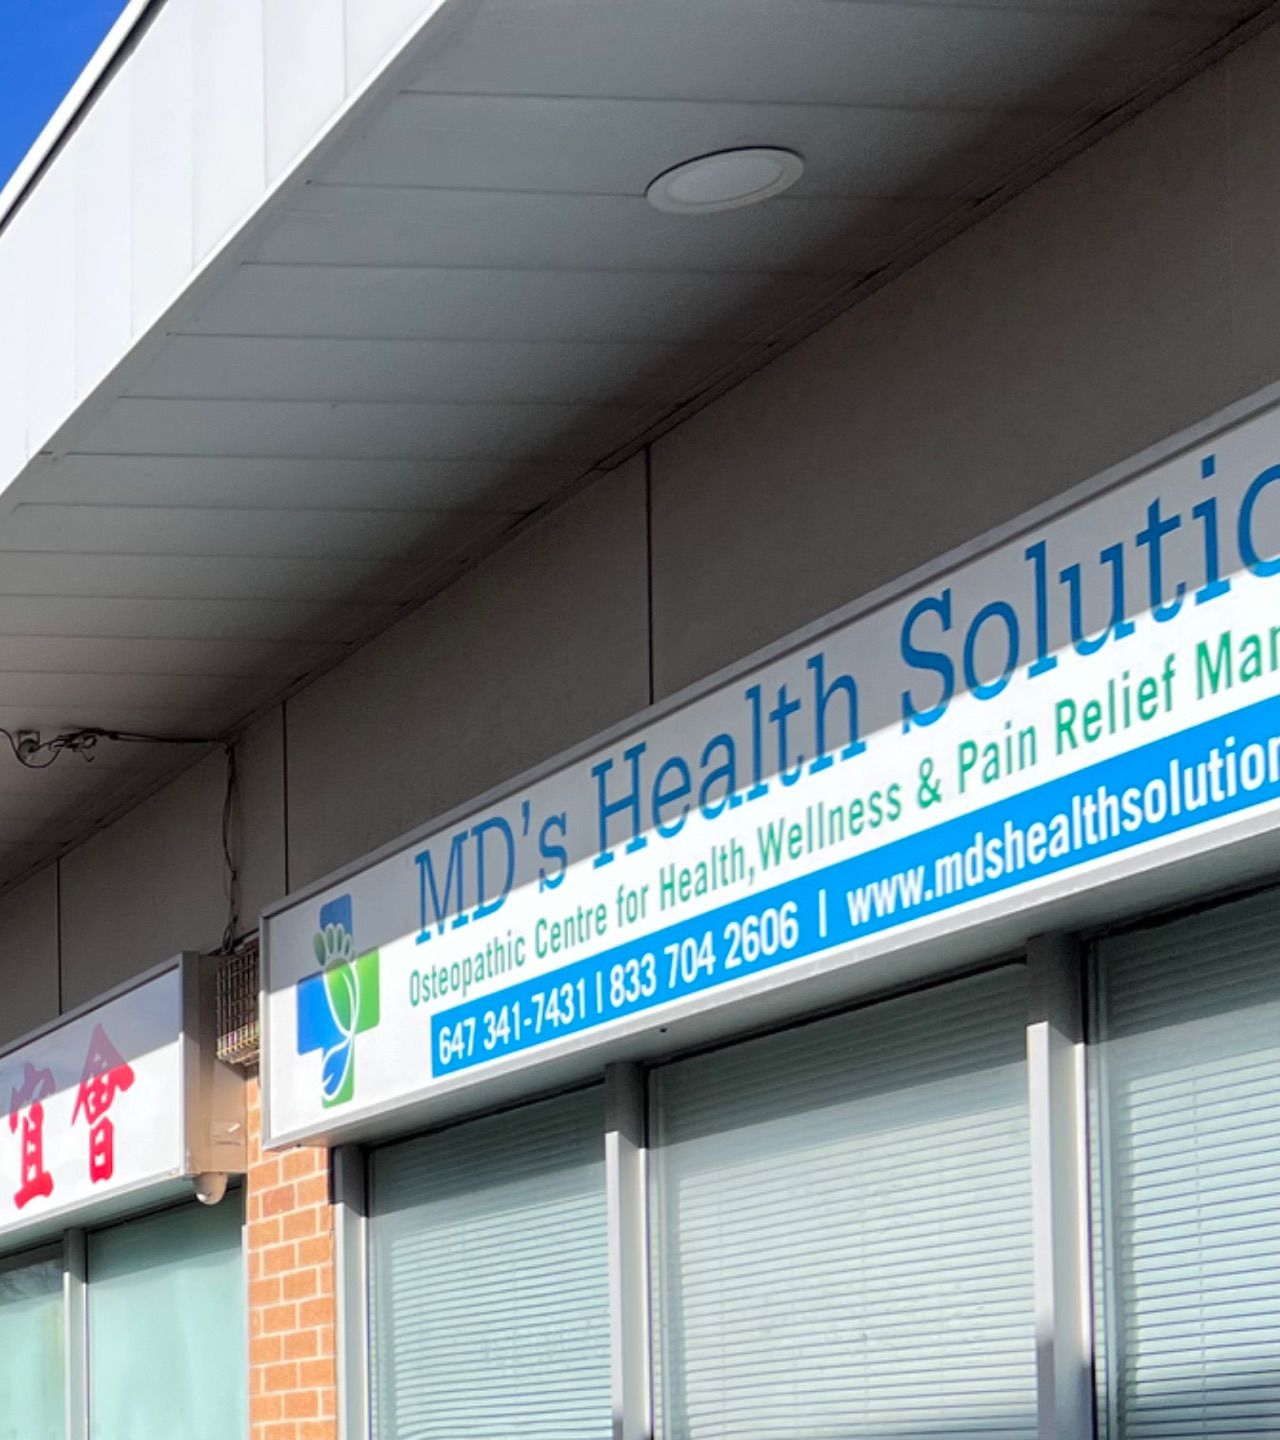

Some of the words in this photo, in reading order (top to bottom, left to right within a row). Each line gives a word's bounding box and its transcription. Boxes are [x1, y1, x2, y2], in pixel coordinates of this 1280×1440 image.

[409, 930, 527, 1008] Osteopathic
[535, 901, 608, 960] Centre
[617, 883, 651, 924] for
[917, 757, 943, 809] &
[957, 720, 1038, 795] Pain
[1054, 652, 1177, 756] Relief
[414, 800, 568, 946] MD's
[591, 652, 867, 869] Health
[439, 1018, 476, 1066] 647
[483, 976, 587, 1051] 341-7431
[610, 953, 657, 1008] 833
[664, 934, 717, 989] 704
[724, 900, 799, 969] 2606
